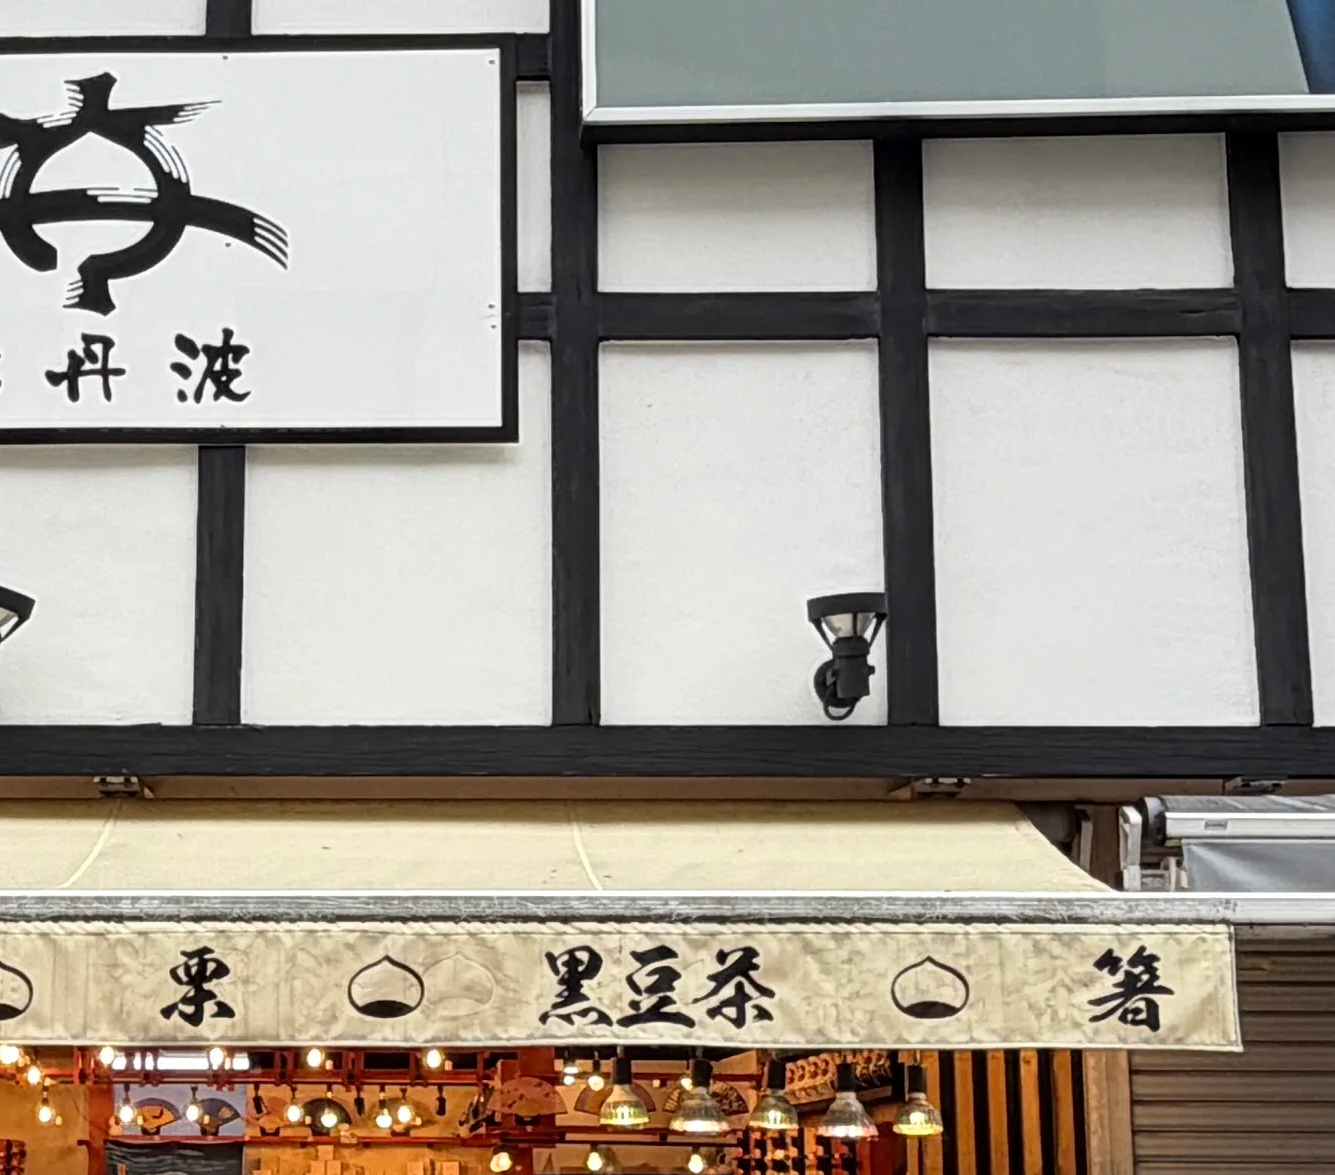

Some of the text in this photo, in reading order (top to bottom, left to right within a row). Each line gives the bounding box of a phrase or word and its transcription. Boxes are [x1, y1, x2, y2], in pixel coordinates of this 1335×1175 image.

[160, 946, 235, 1027] 栗
[539, 945, 775, 1029] 黒豆茶
[1088, 946, 1174, 1032] 箸
